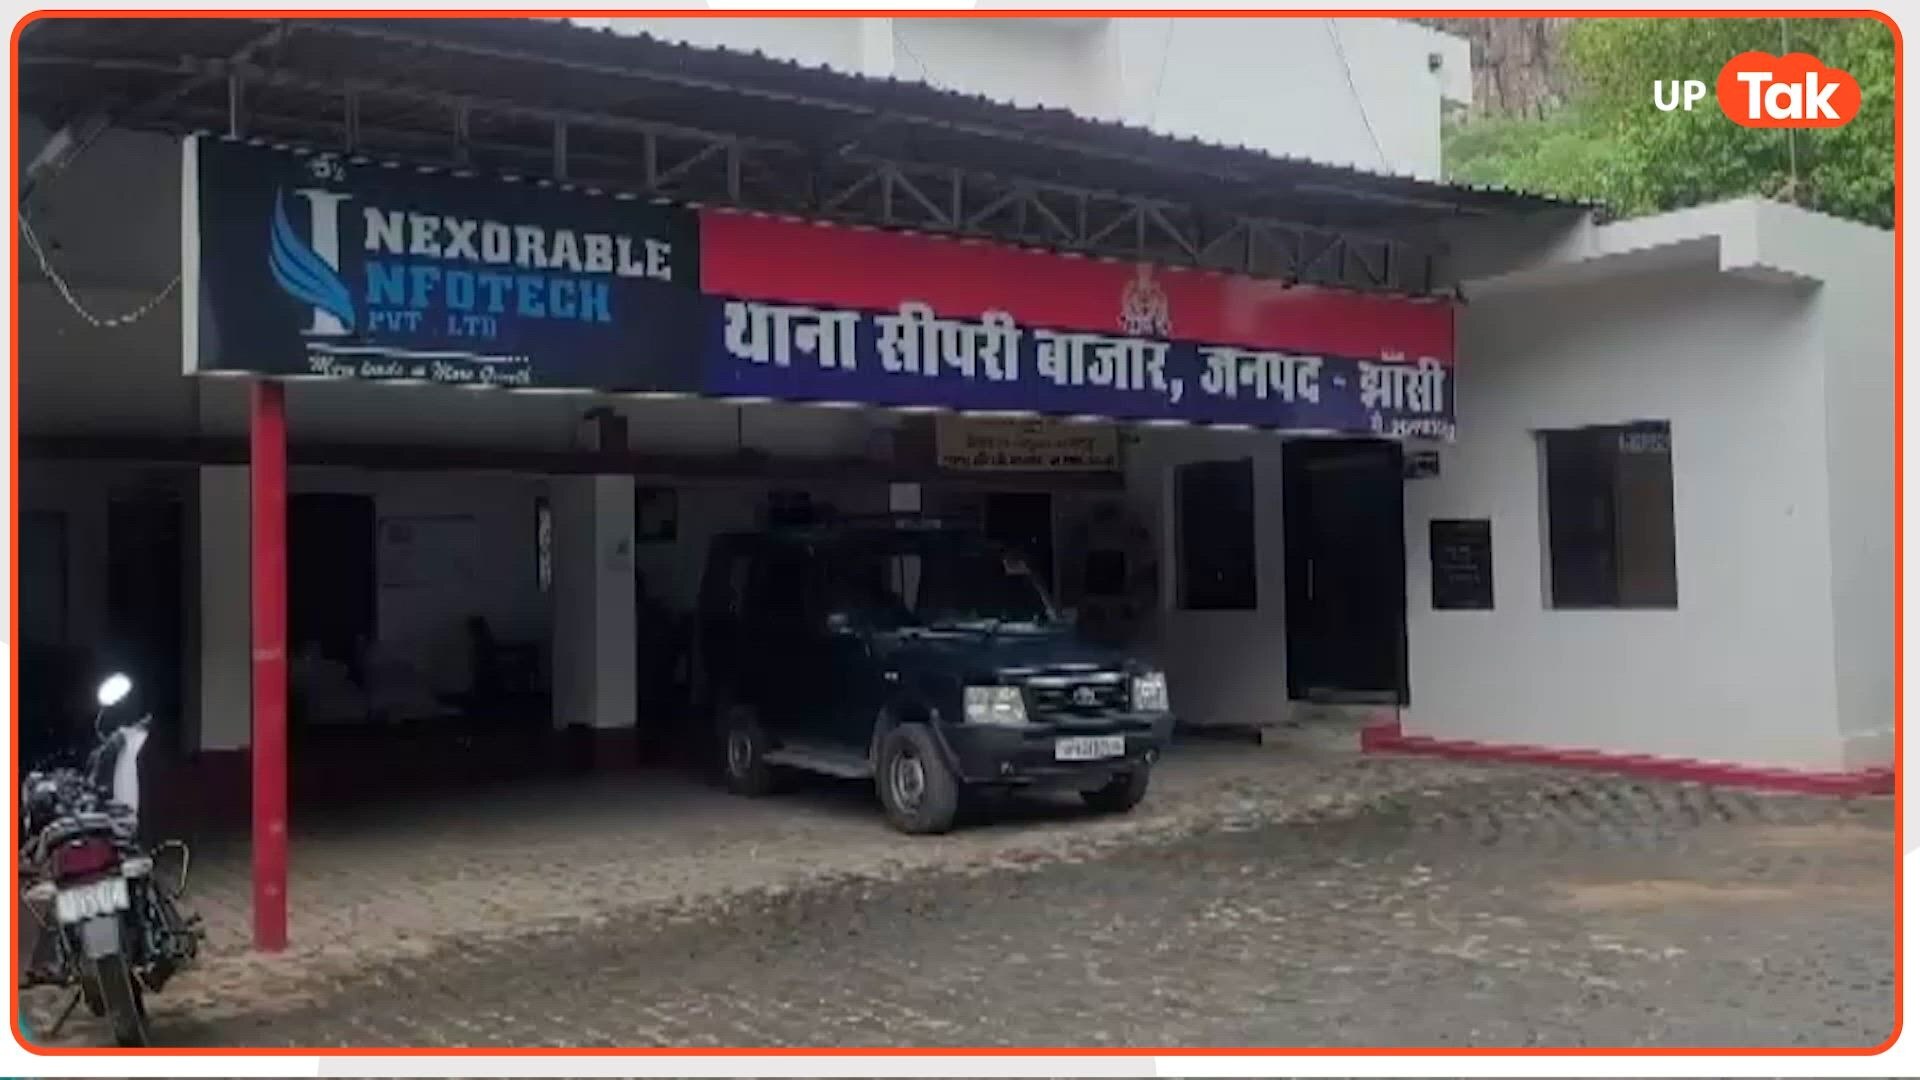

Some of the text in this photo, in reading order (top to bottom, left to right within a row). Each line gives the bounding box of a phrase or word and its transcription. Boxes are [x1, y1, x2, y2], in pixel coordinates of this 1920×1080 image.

[364, 206, 672, 281] NEXORABLE
[365, 262, 612, 322] NFOTECH
[723, 301, 862, 370] थाना
[874, 301, 1023, 382] सीपरी
[1034, 329, 1184, 403] बाजार,
[1197, 346, 1324, 403] जनपद
